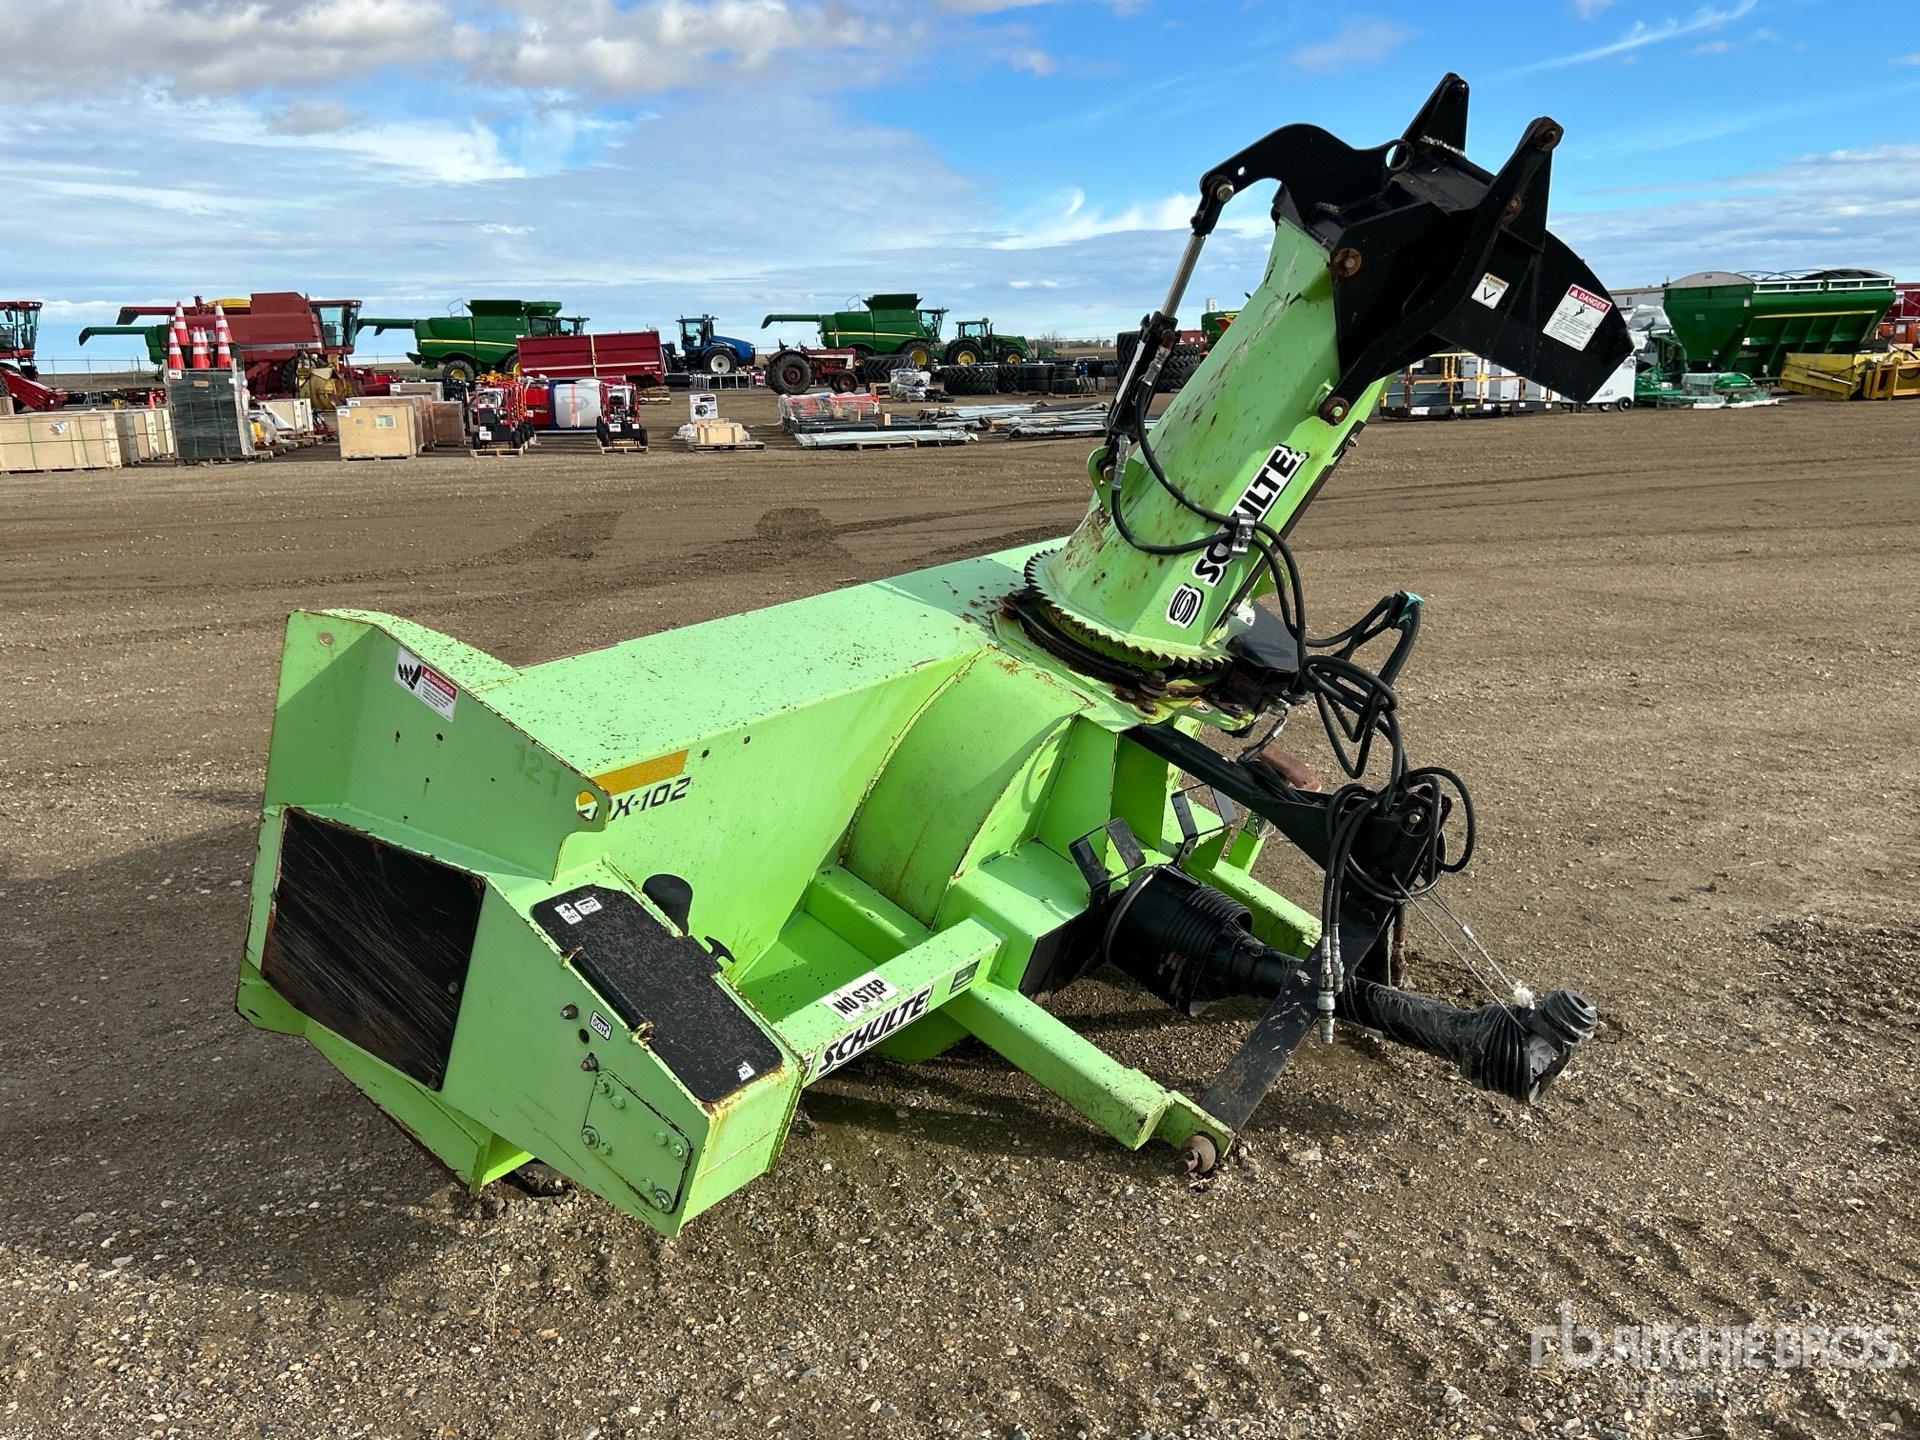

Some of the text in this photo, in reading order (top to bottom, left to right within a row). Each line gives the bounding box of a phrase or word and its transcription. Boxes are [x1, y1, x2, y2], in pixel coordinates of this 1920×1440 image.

[1579, 291, 1608, 311] DANGER
[1194, 444, 1298, 587] SCULTE
[430, 675, 455, 697] DANGER
[832, 979, 888, 1015] NO STEP
[817, 989, 931, 1074] SCHULTE
